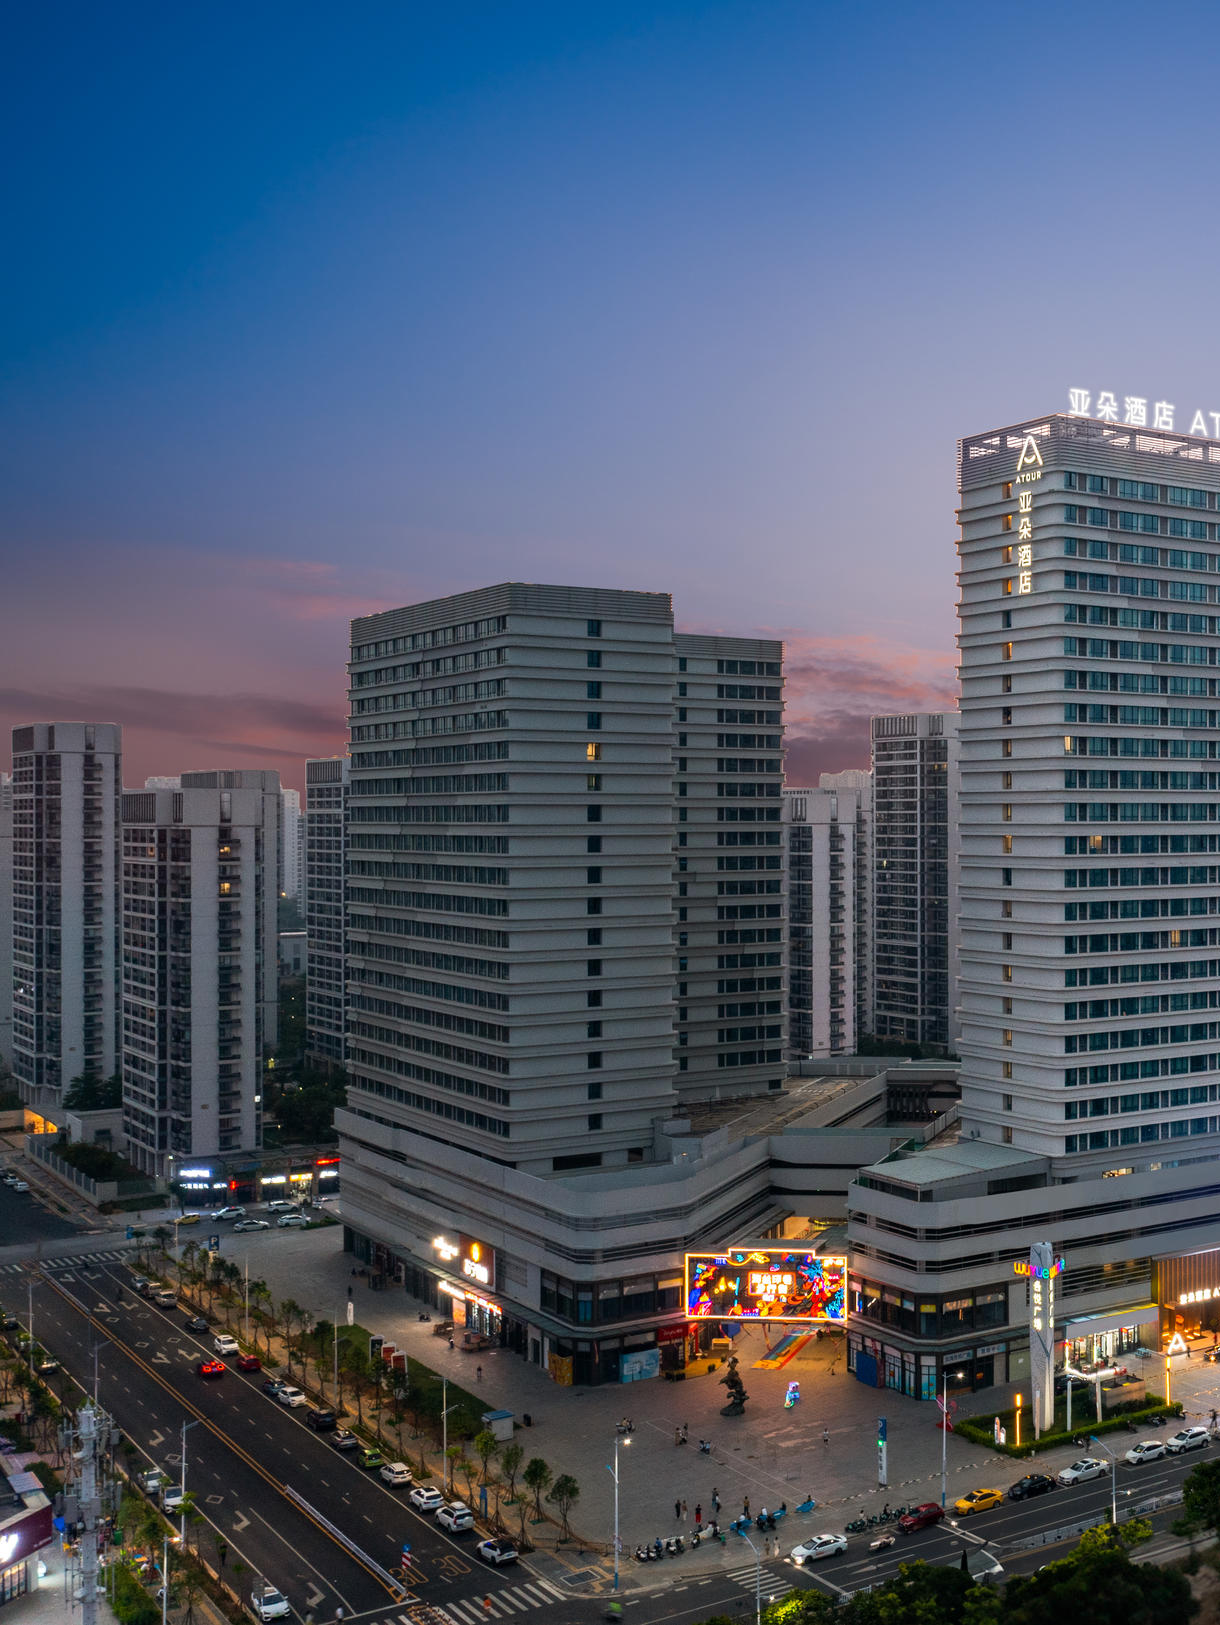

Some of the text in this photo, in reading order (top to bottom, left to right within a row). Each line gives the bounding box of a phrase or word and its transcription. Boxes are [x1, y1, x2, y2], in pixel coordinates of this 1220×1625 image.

[1069, 388, 1175, 432] 亚朵酒店
[1015, 471, 1042, 484] ATOUR
[1018, 491, 1032, 594] 亚朵酒店
[432, 1555, 472, 1577] 30
